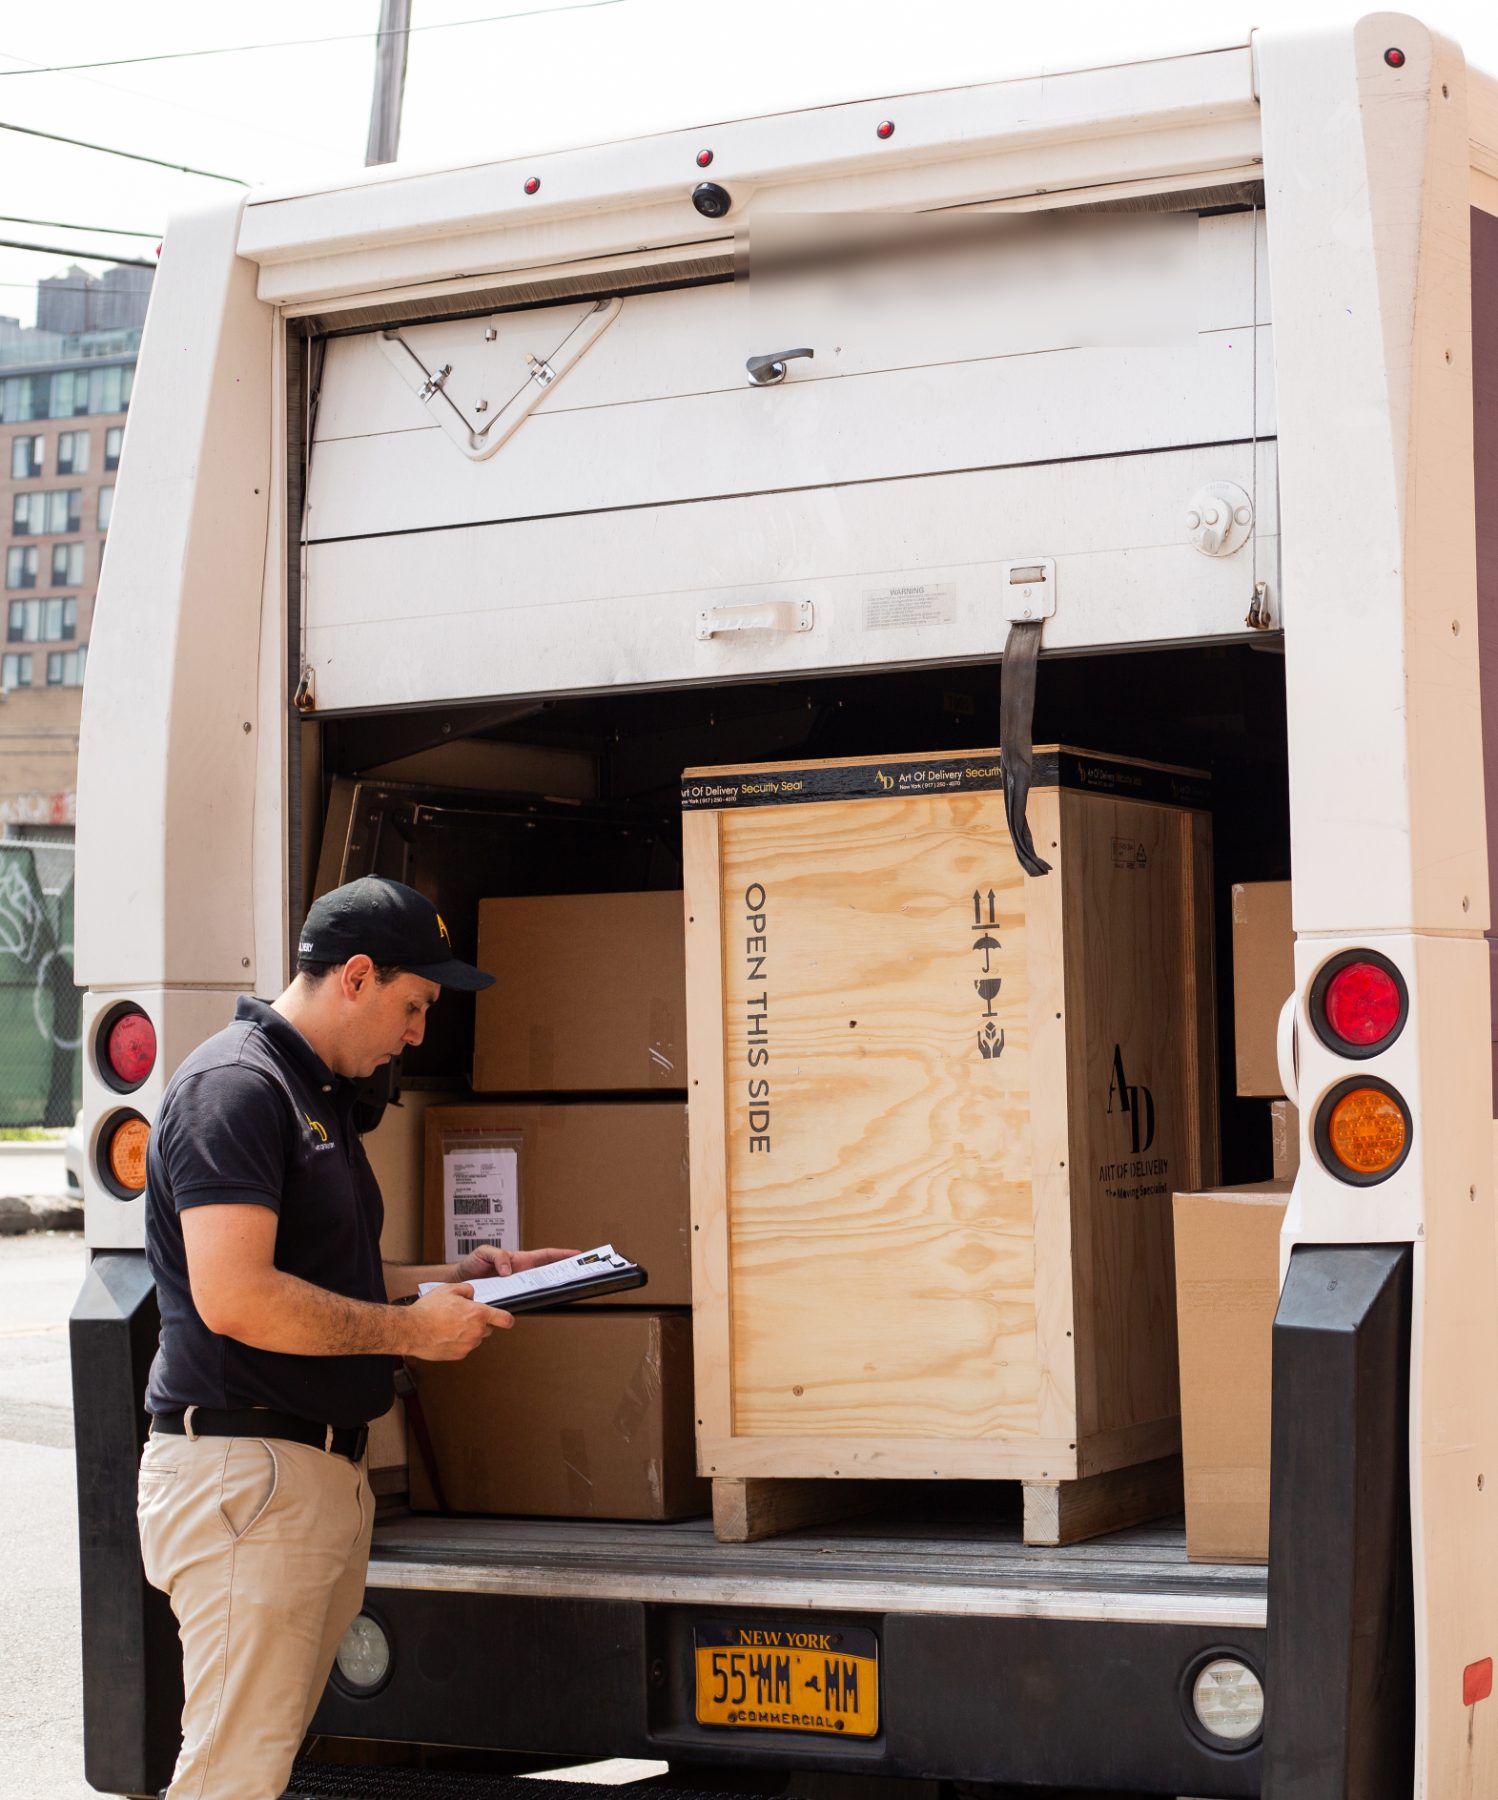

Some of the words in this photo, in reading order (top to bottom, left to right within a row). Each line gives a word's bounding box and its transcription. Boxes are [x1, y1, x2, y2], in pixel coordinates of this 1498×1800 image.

[889, 586, 925, 596] WARNING
[899, 773, 911, 783] Art
[913, 770, 926, 782] Of
[928, 769, 962, 782] Delivery
[692, 786, 704, 797] Of
[706, 785, 739, 797] Delivery
[741, 782, 779, 794] Security
[781, 780, 803, 791] Seal
[745, 882, 767, 980] OPEN
[747, 991, 769, 1068] THIS
[748, 1079, 770, 1153] SIDE
[1099, 1164, 1115, 1182] ART
[1117, 1163, 1128, 1179] OF
[1130, 1159, 1168, 1178] DELIVERY
[1118, 1187, 1139, 1200] Moving
[739, 1630, 781, 1646] NEW
[785, 1632, 832, 1650] YORK
[738, 1710, 834, 1728] COMMERCIAL
